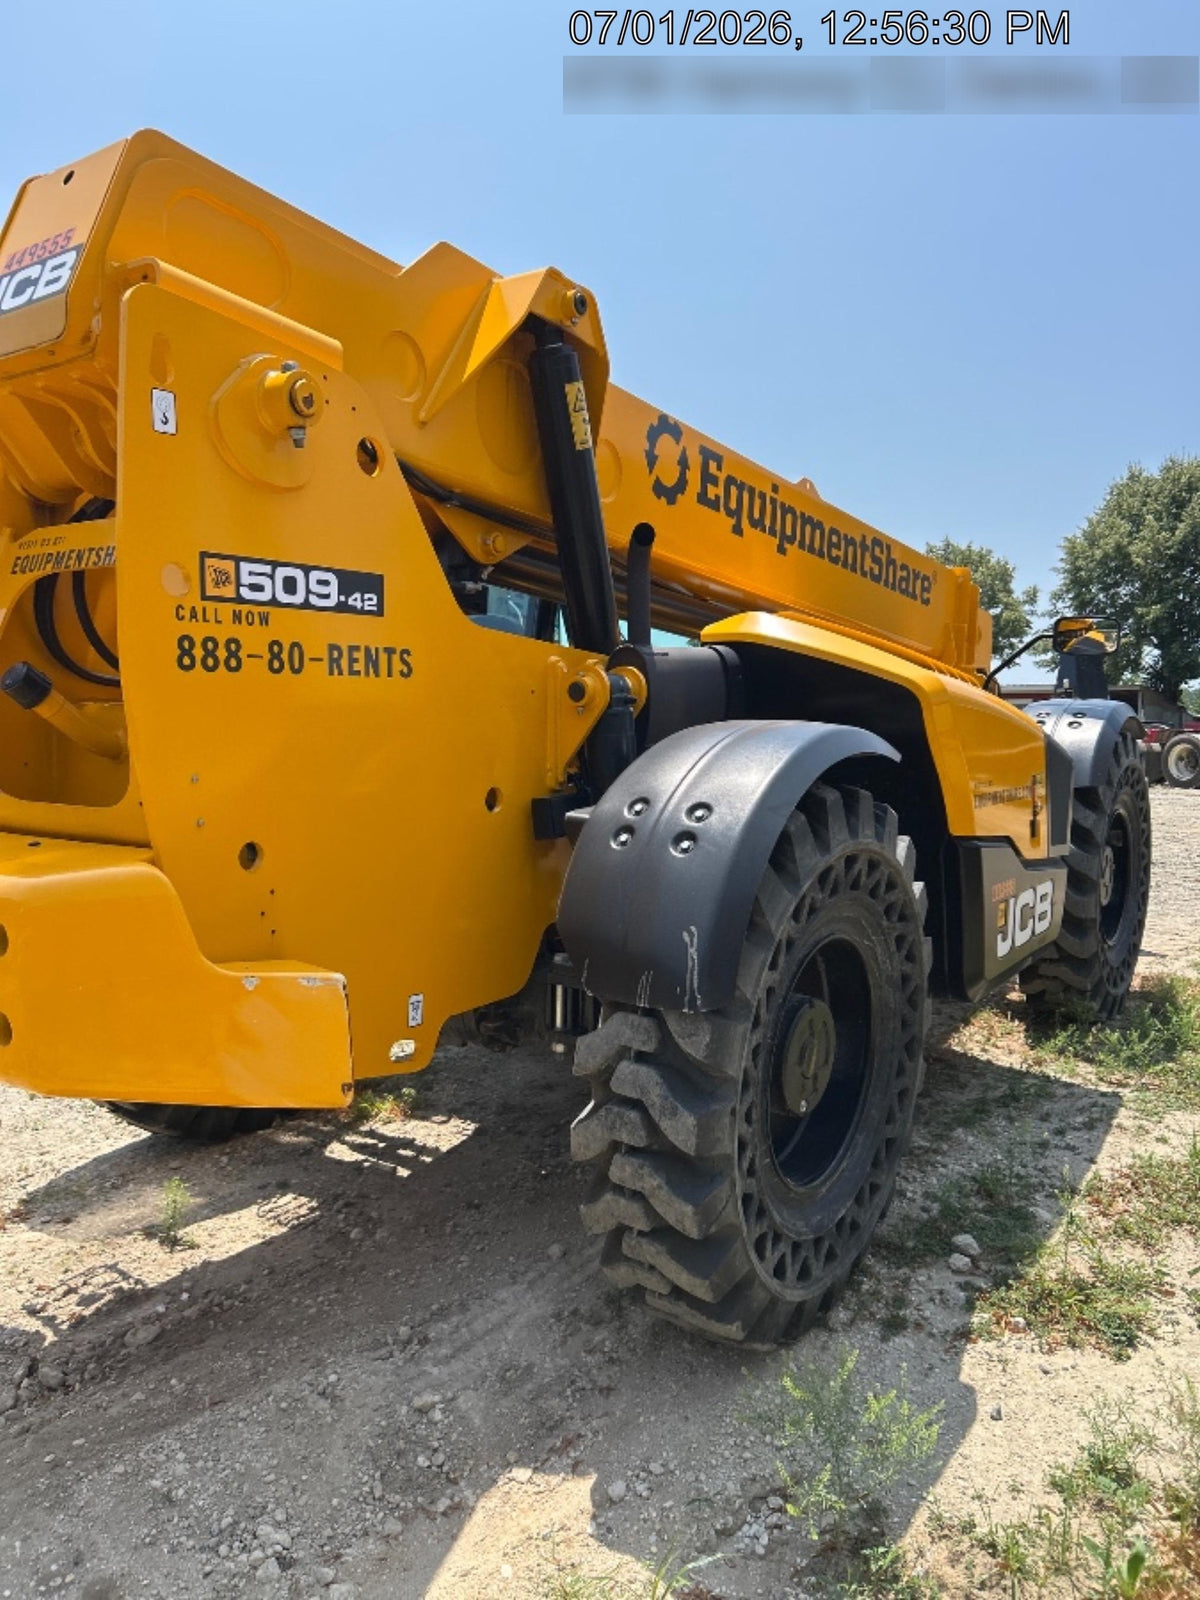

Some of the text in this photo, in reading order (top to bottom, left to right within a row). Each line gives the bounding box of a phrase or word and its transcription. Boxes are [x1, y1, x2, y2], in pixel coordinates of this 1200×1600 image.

[4, 227, 76, 270] 449555
[10, 544, 117, 575] EQUIPMENTSH
[175, 604, 271, 627] CALL NOW
[176, 634, 414, 680] 888-80-RENTS
[996, 880, 1054, 957] JCB
